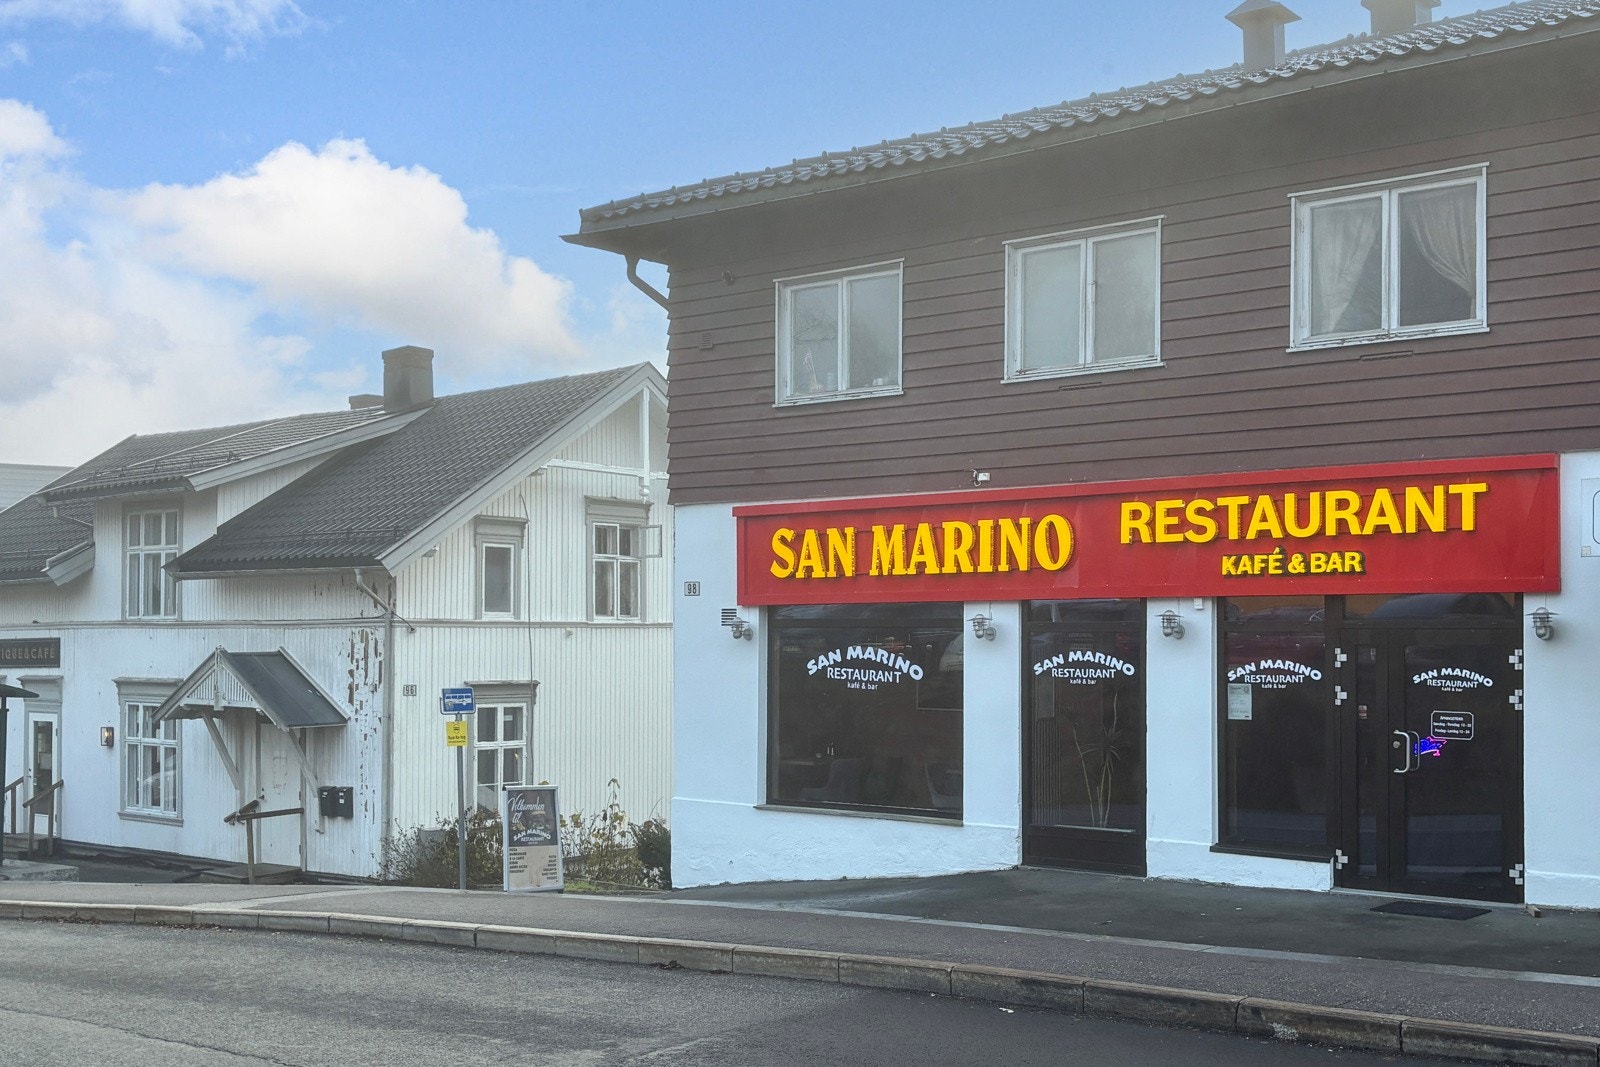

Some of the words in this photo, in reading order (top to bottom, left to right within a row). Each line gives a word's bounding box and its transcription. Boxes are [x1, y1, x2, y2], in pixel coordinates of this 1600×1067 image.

[1120, 483, 1488, 544] RESTAURANT
[769, 526, 857, 579] SAN
[869, 514, 1074, 577] MARINO
[1221, 547, 1283, 576] KAFÉ
[1287, 553, 1305, 574] &
[1310, 551, 1363, 574] BAR
[687, 583, 697, 595] 98
[806, 648, 842, 676] SAN
[846, 645, 924, 680] MARINO
[1033, 653, 1065, 675] SAN
[1068, 650, 1135, 676] MARINO
[1227, 662, 1256, 681] SAN
[1259, 659, 1322, 680] MARINO
[827, 667, 902, 683] RESTAURANT
[1051, 668, 1117, 678] RESTAURANT
[1244, 674, 1305, 683] RESTAURANT
[1412, 669, 1438, 684] SAN
[1440, 667, 1494, 687] MARINO
[405, 686, 415, 695] 96
[847, 681, 860, 689] kafé
[861, 682, 866, 690] &
[1427, 679, 1479, 688] RESTAURANT
[513, 830, 526, 841] SAN
[527, 828, 551, 840] MARINO
